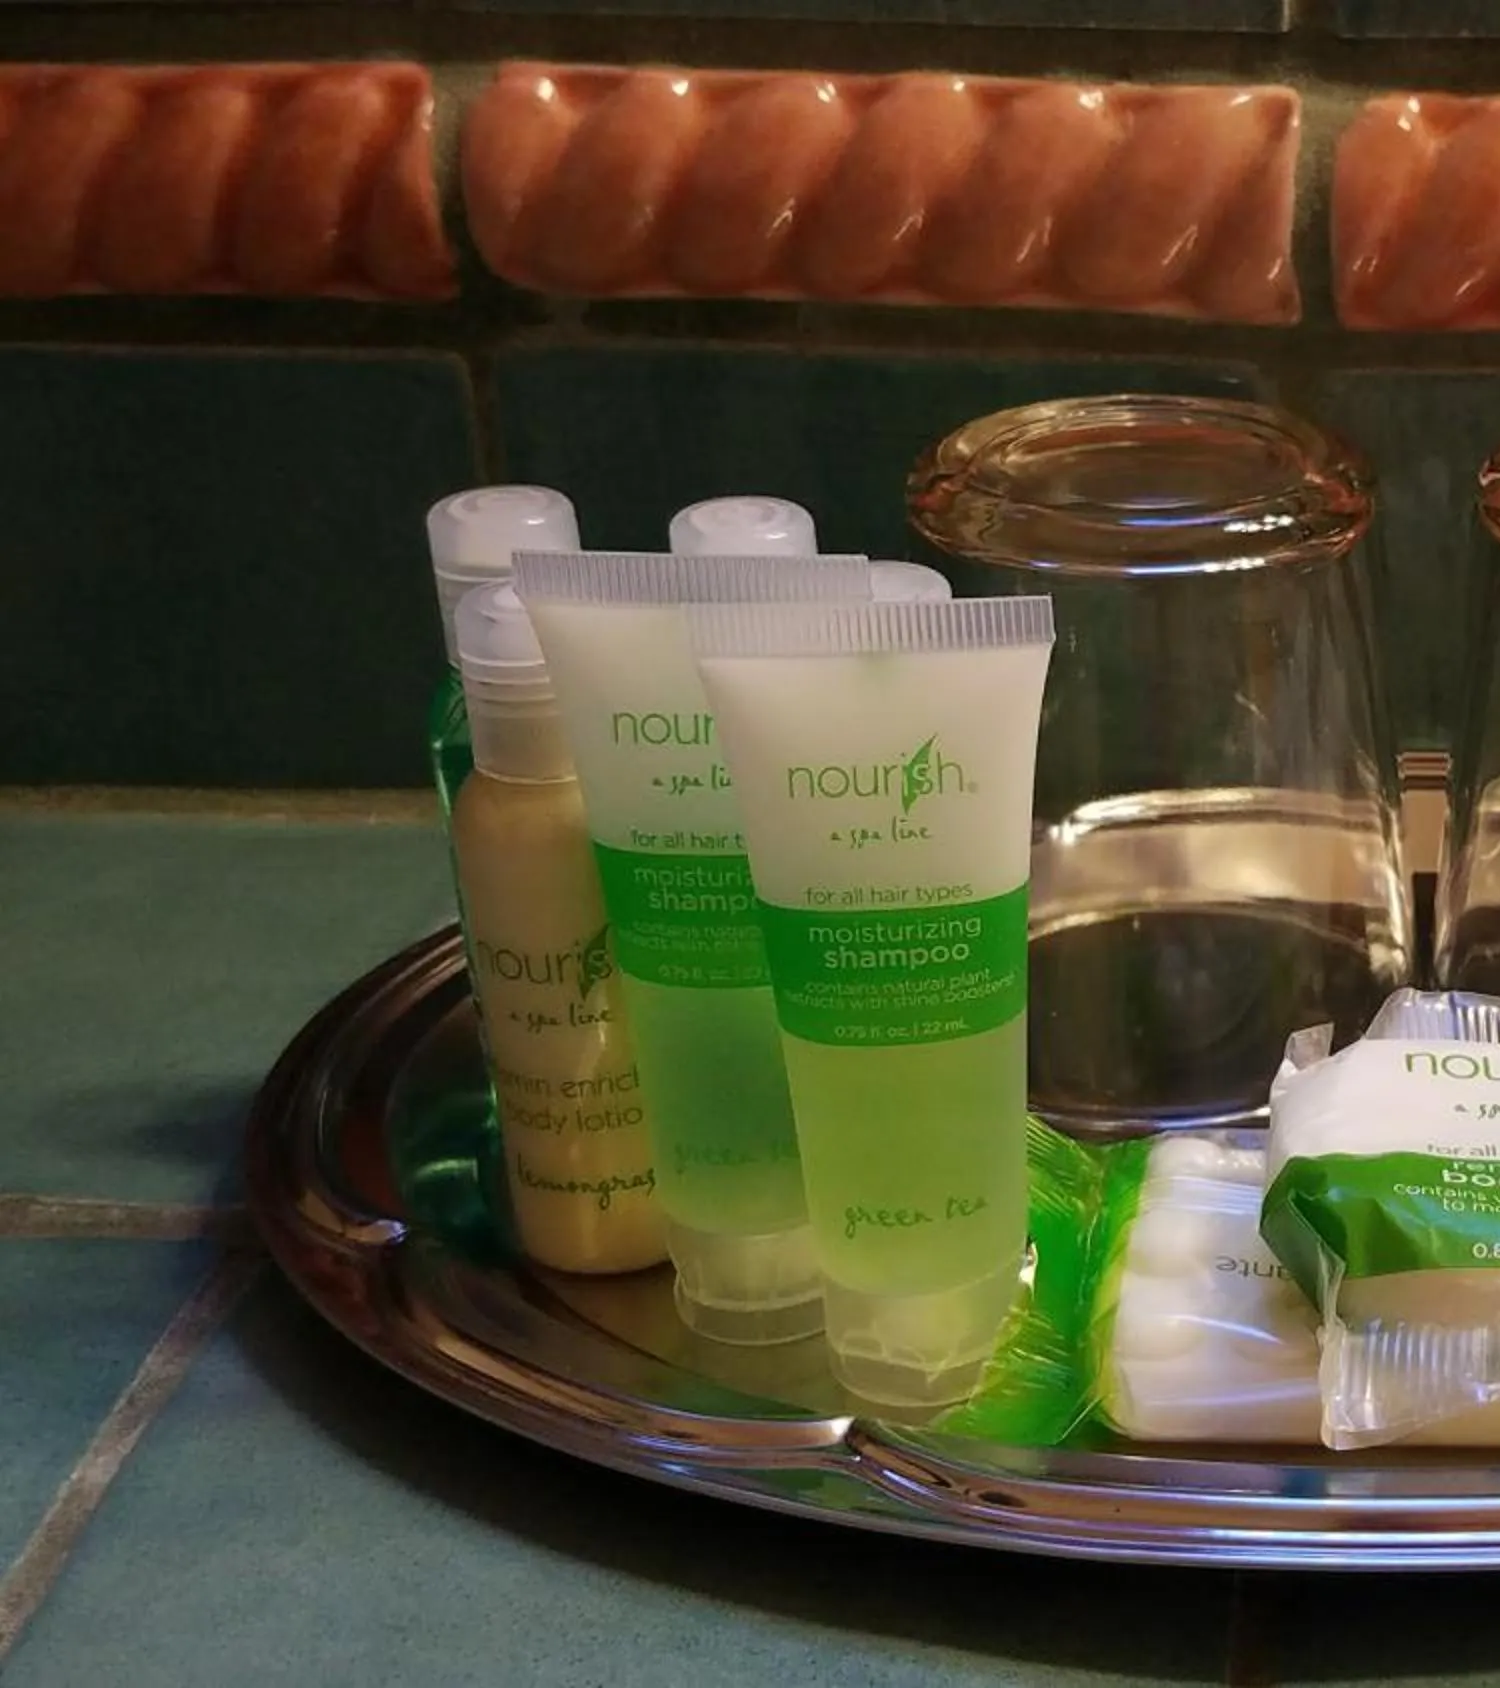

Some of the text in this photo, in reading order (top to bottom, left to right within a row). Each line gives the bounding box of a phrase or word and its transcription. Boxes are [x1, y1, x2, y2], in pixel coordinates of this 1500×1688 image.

[613, 712, 715, 745] nour
[711, 763, 733, 790] li
[787, 749, 966, 800] nourish
[631, 829, 657, 847] for
[663, 831, 685, 848] all
[690, 831, 729, 849] hair
[850, 829, 882, 849] spa
[892, 815, 933, 842] line
[633, 866, 749, 888] moisturi
[648, 888, 756, 915] shamp
[804, 882, 974, 906] for all hair types
[808, 916, 982, 945] moisturizing
[477, 936, 613, 986] nouris
[823, 942, 970, 970] shampoo
[804, 967, 991, 998] contains natural plant
[851, 993, 889, 1011] with
[893, 988, 941, 1008] shine
[528, 1012, 561, 1035] spa
[569, 1001, 616, 1028] line
[576, 1106, 644, 1133] lotio
[1469, 1143, 1498, 1157] all
[516, 1151, 657, 1211] lemongras
[1393, 1183, 1488, 1203] contains
[844, 1195, 988, 1240] green tea
[1442, 1198, 1466, 1213] to
